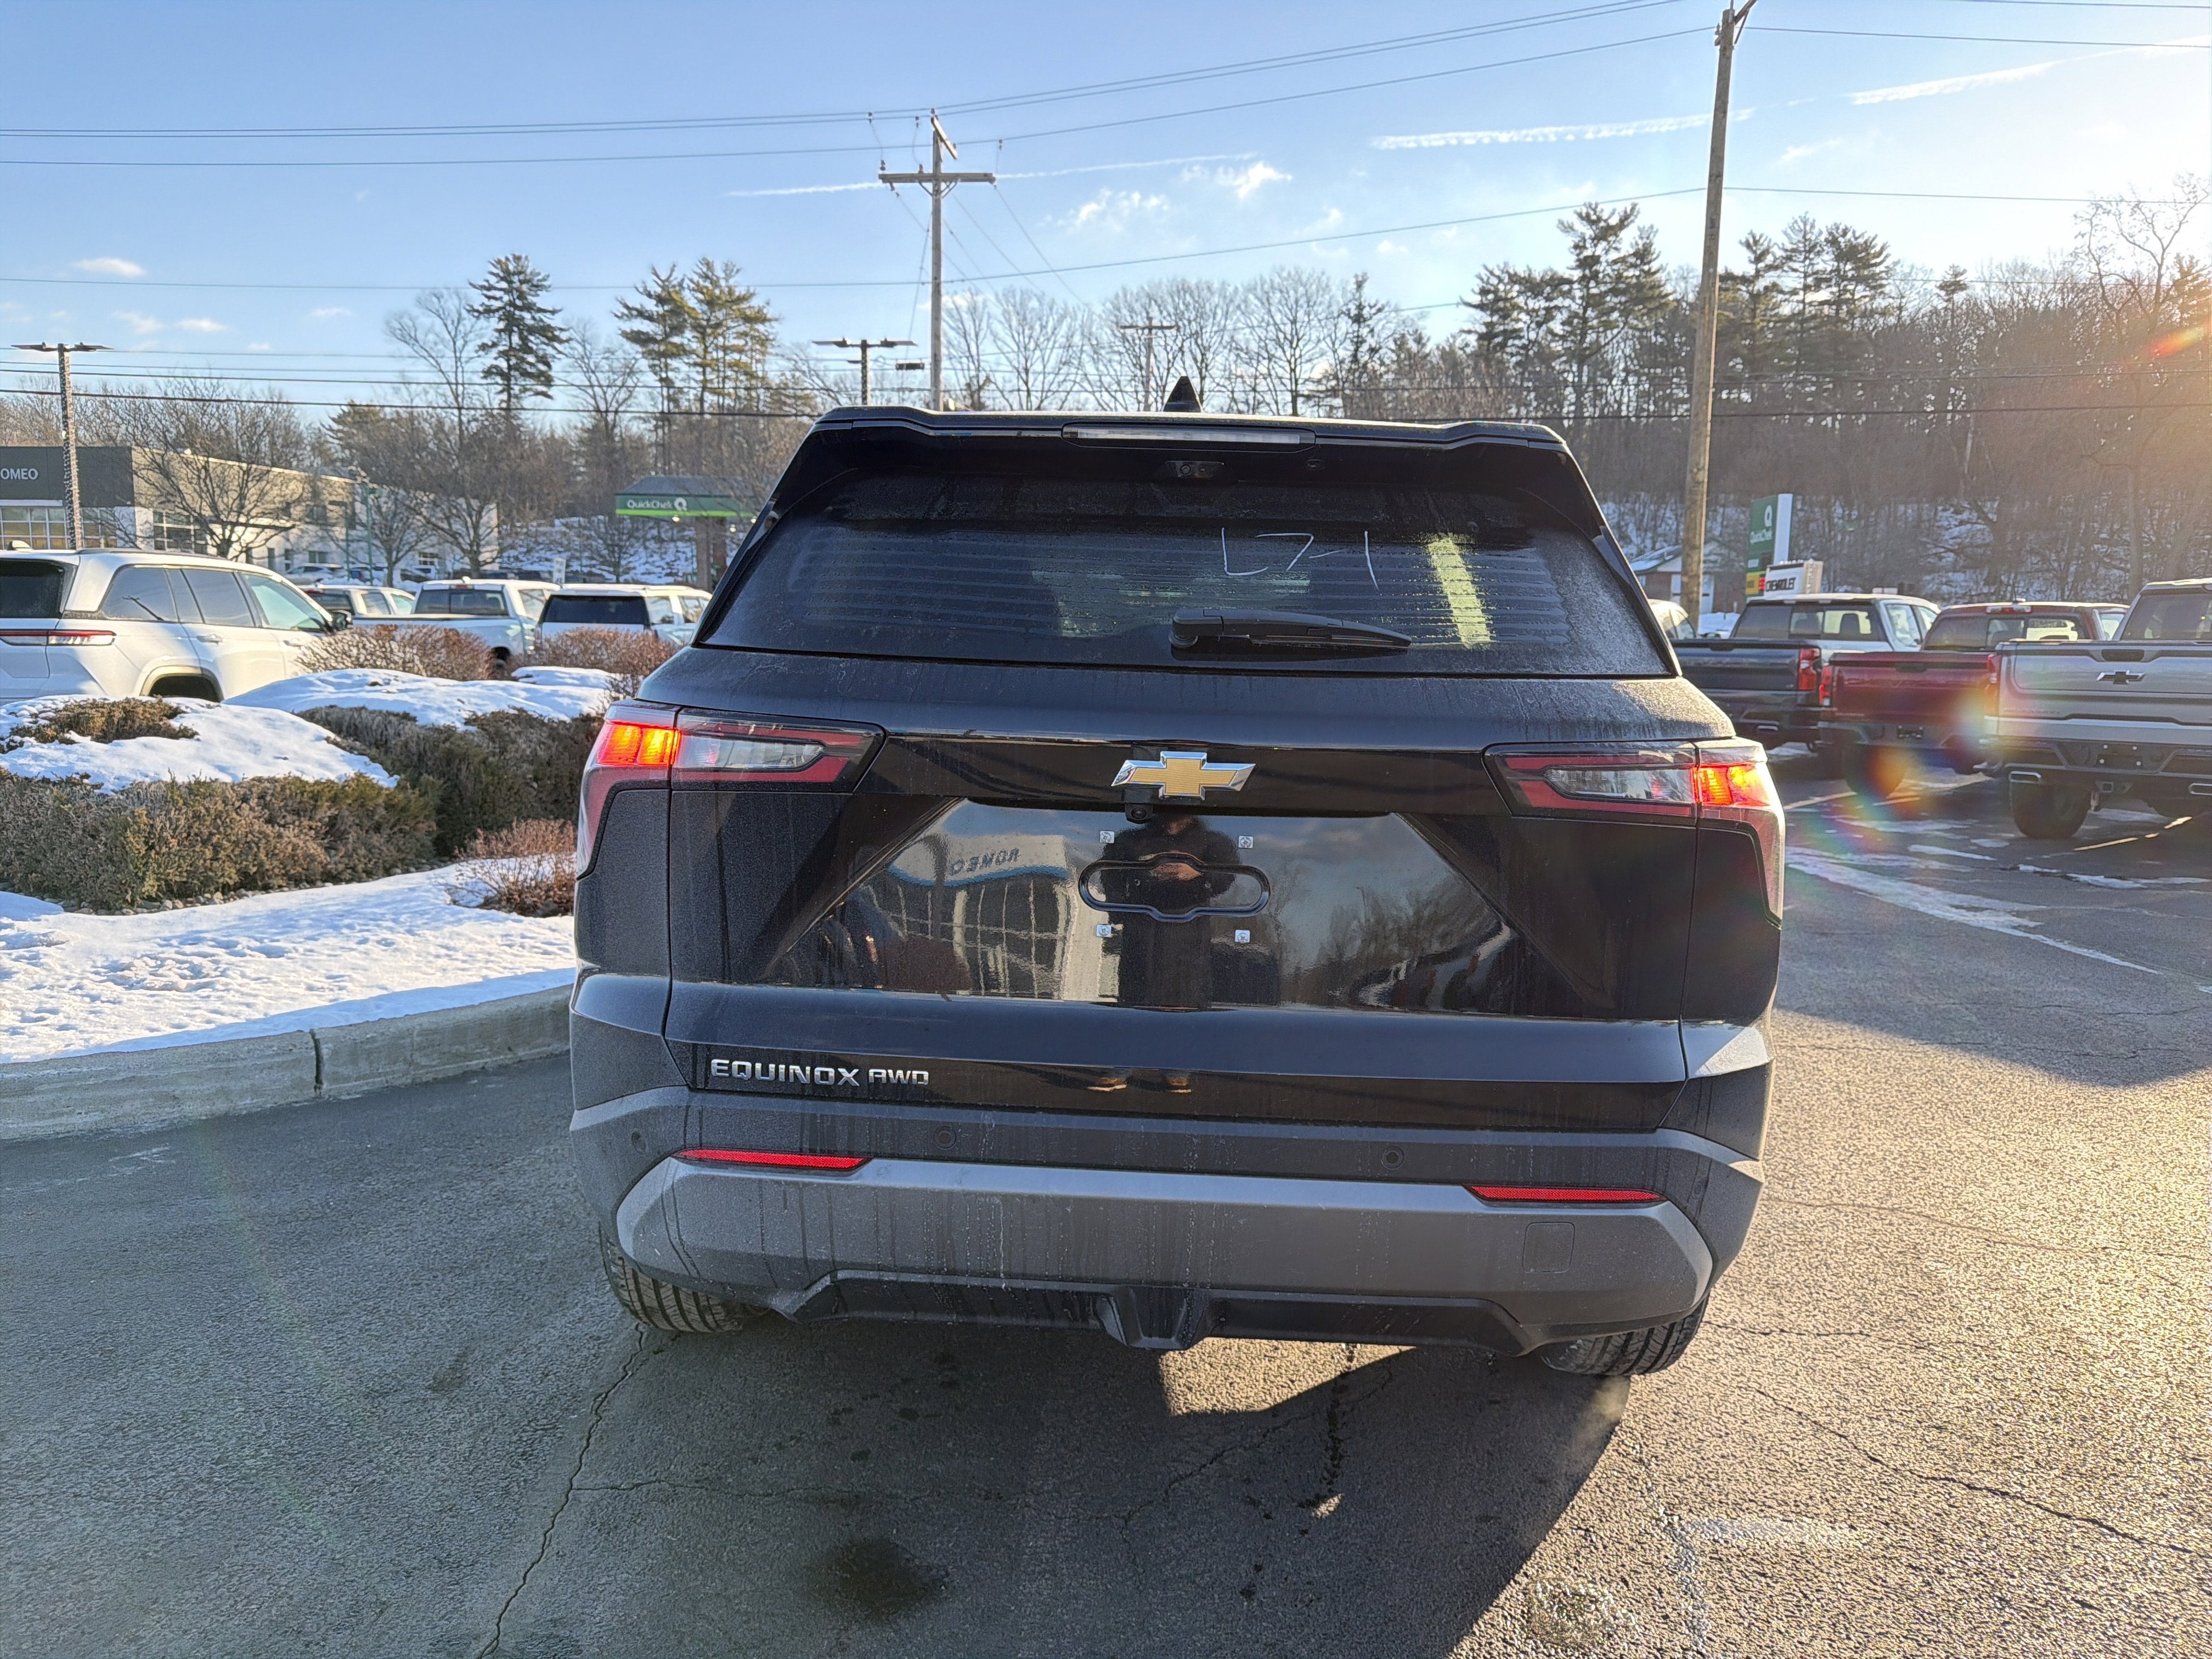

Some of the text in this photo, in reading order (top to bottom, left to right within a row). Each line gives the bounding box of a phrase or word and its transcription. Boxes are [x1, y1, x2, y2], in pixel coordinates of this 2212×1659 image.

[1, 468, 38, 480] OMEO
[711, 1059, 929, 1086] EQUINOX AWD
